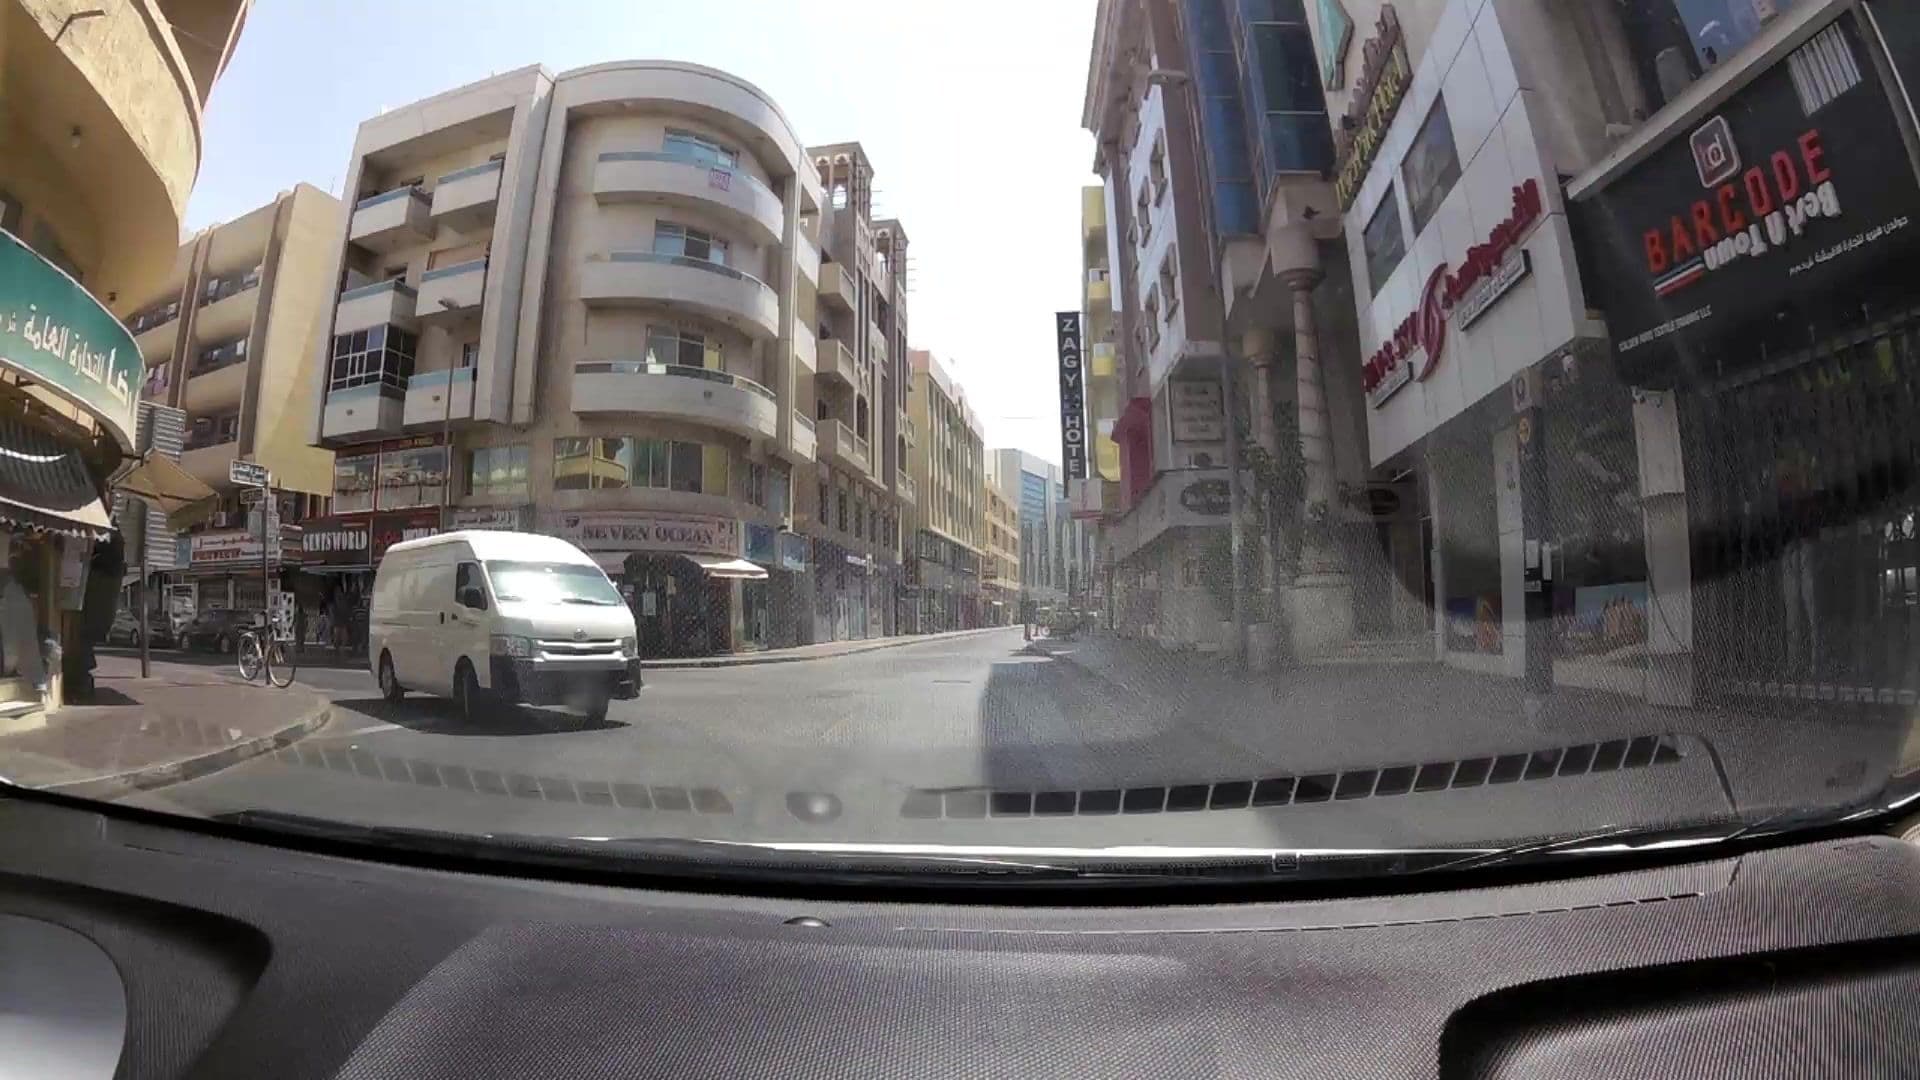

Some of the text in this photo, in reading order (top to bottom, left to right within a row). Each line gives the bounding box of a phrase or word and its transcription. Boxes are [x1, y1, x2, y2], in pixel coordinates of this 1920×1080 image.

[1643, 128, 1832, 273] BARCODE
[23, 303, 70, 361] العامة
[1062, 319, 1078, 388] ZAGY
